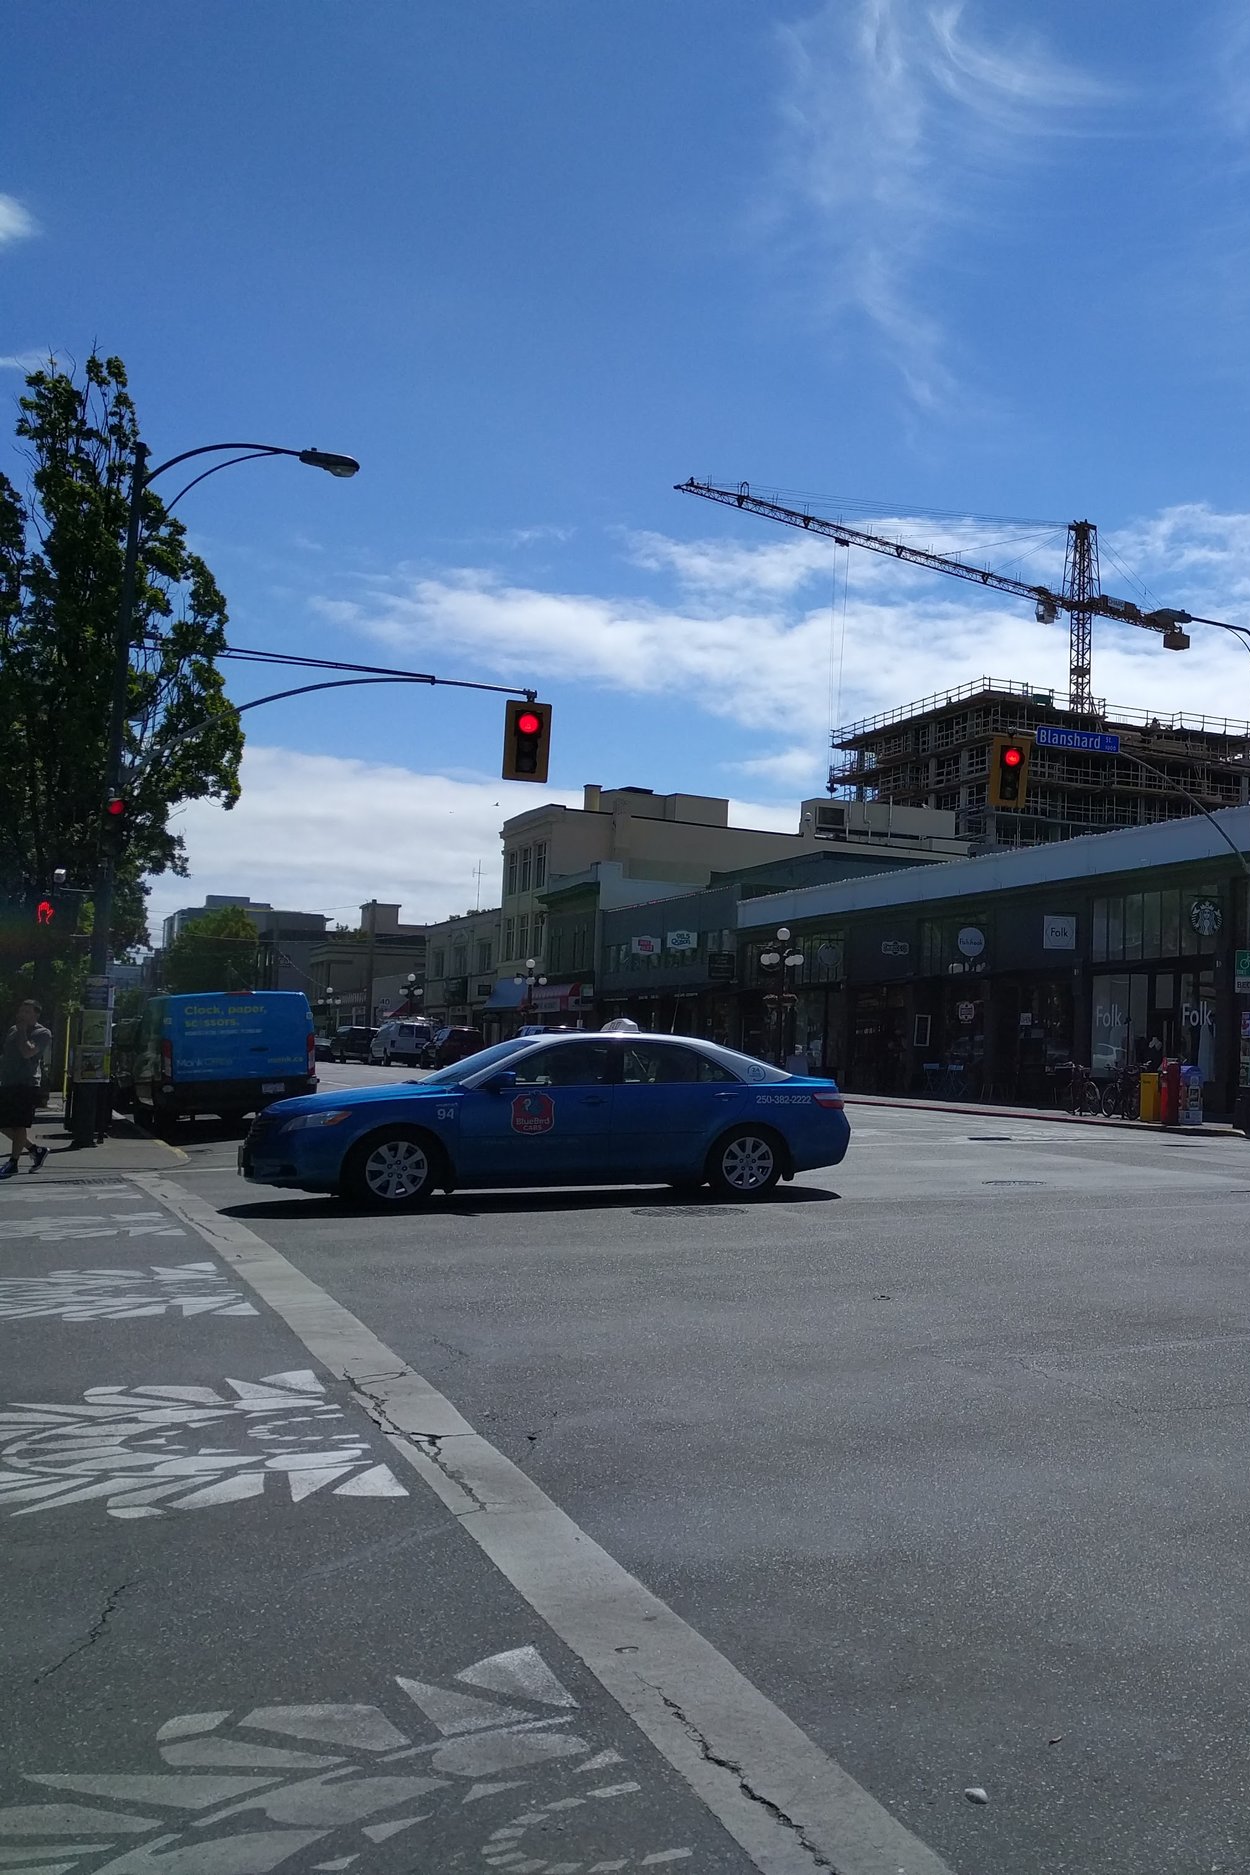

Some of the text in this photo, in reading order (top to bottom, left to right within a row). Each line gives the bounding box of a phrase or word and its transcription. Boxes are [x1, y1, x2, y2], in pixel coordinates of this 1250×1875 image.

[1040, 729, 1101, 749] Blanshard
[1050, 927, 1069, 937] Folk
[1096, 1003, 1122, 1027] Folk
[1182, 1001, 1213, 1027] Folk
[756, 1095, 812, 1105] 250-382-2222
[437, 1108, 454, 1120] 94
